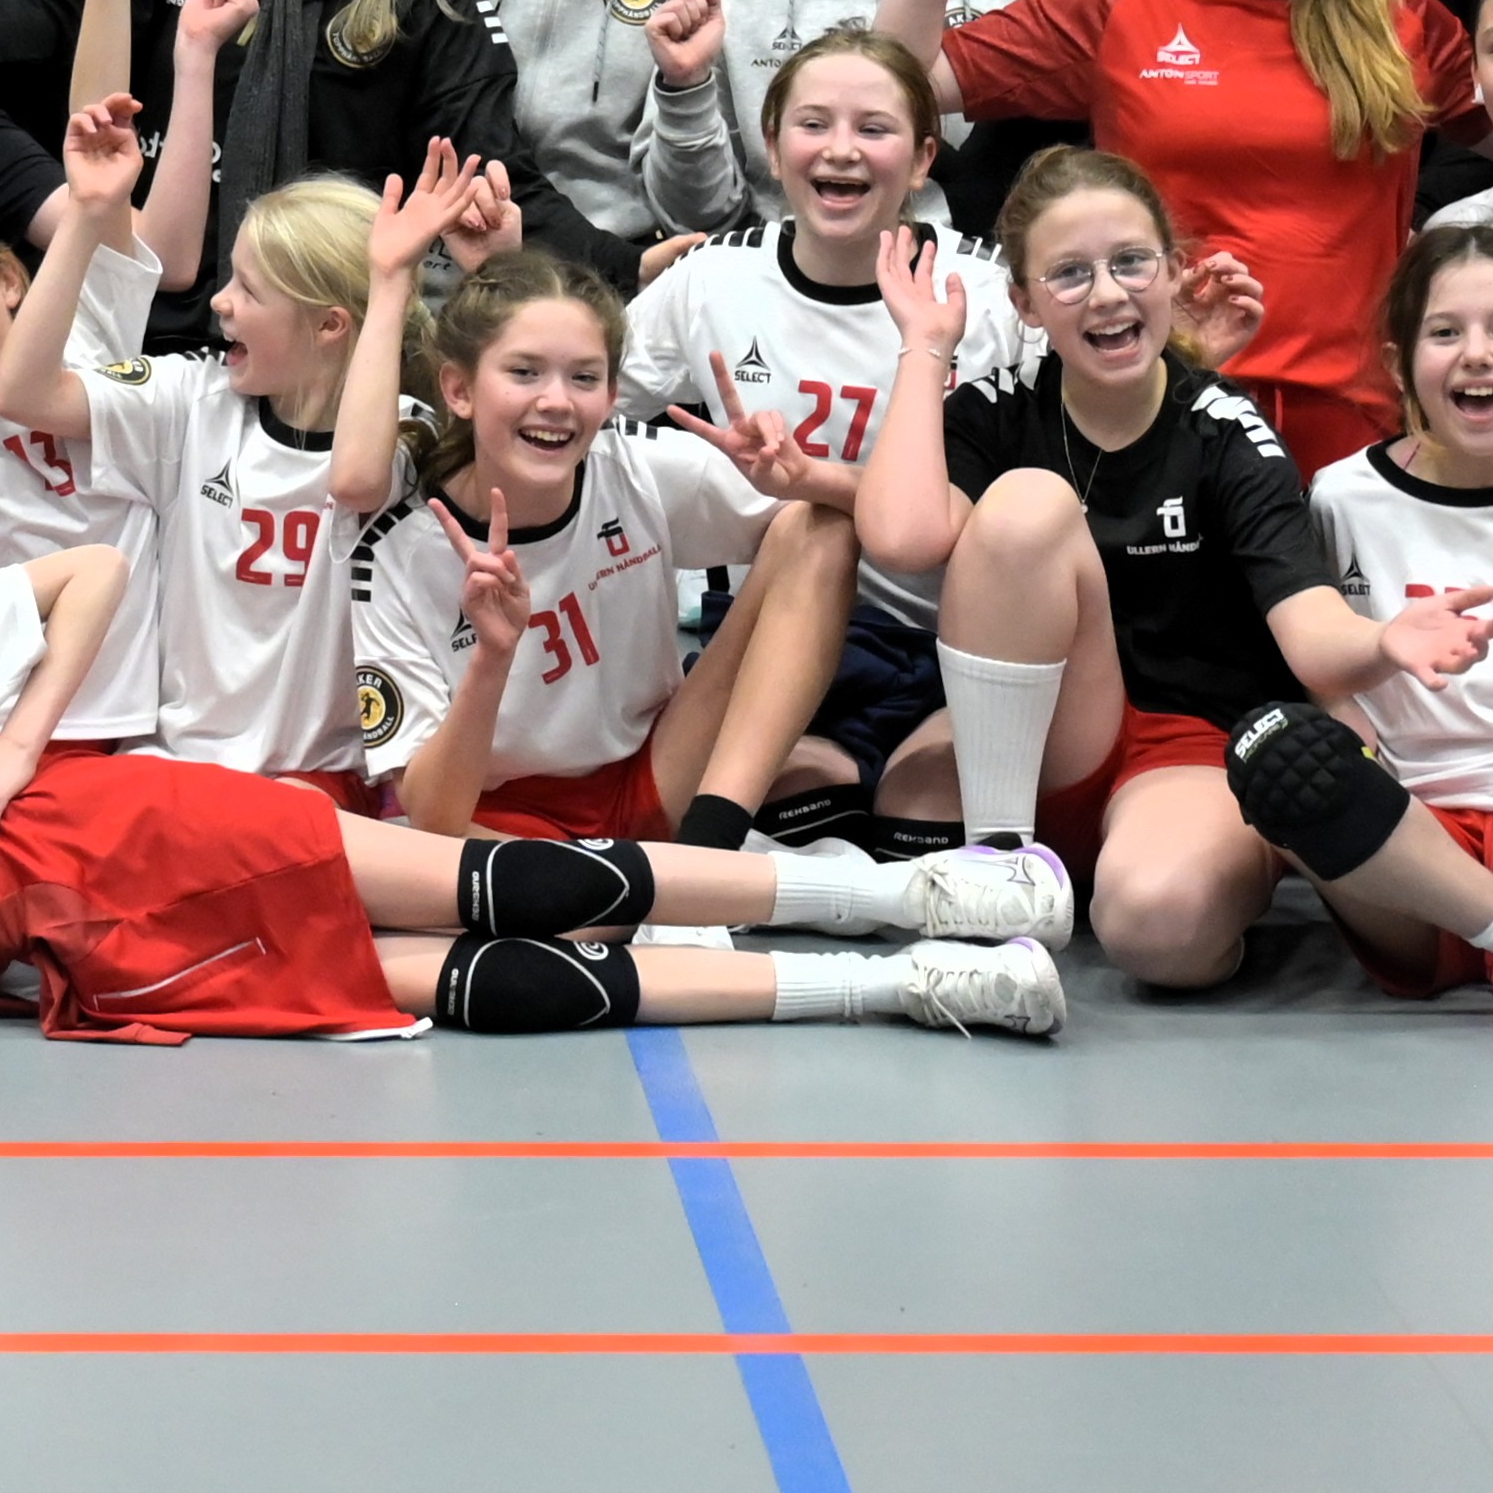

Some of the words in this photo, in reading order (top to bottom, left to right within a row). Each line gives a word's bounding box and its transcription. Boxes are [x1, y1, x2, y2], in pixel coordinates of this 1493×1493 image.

[1157, 50, 1201, 66] SELECT
[734, 369, 771, 384] SELECT
[793, 379, 878, 462] 27
[199, 484, 233, 509] SELECT
[236, 507, 321, 588] 29
[1126, 543, 1166, 555] ULLERN
[528, 591, 600, 685] 31
